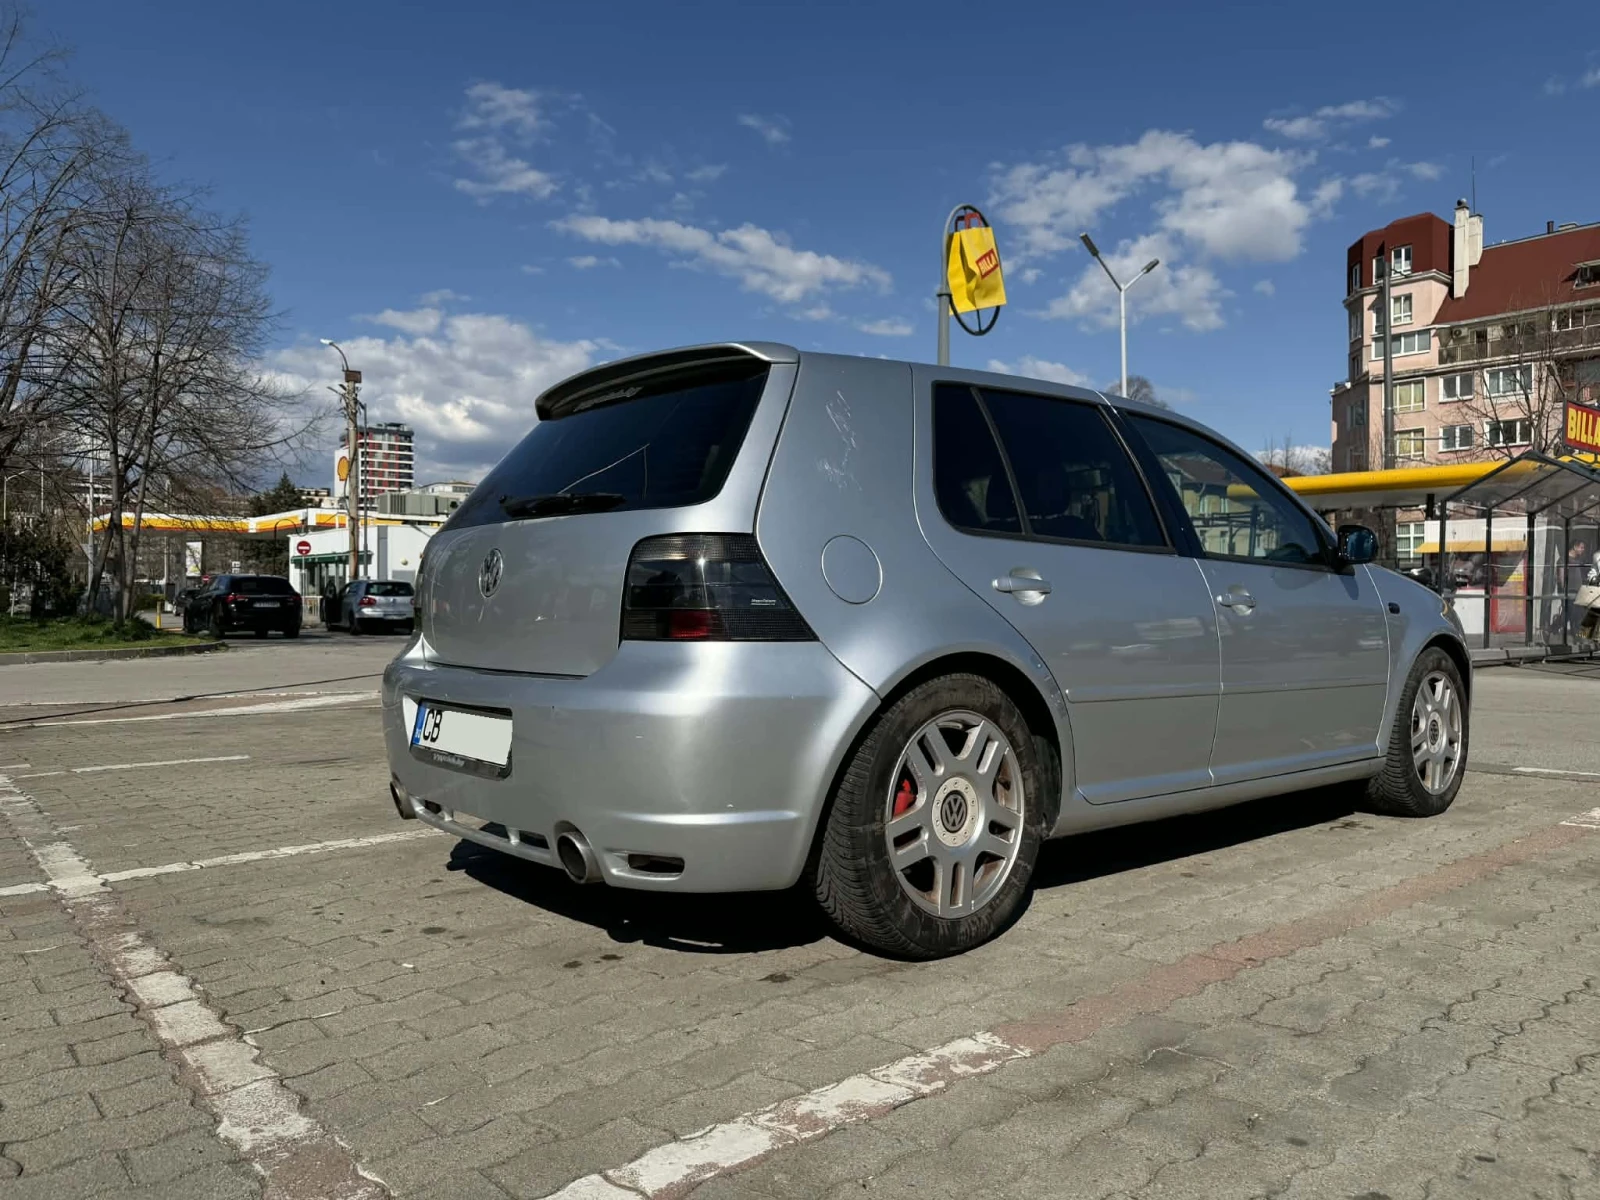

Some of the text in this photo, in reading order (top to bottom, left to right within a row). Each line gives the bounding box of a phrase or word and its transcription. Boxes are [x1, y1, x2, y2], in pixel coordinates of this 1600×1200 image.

[978, 252, 998, 276] BILLA
[1567, 407, 1600, 447] BILLA
[423, 708, 442, 742] CB
